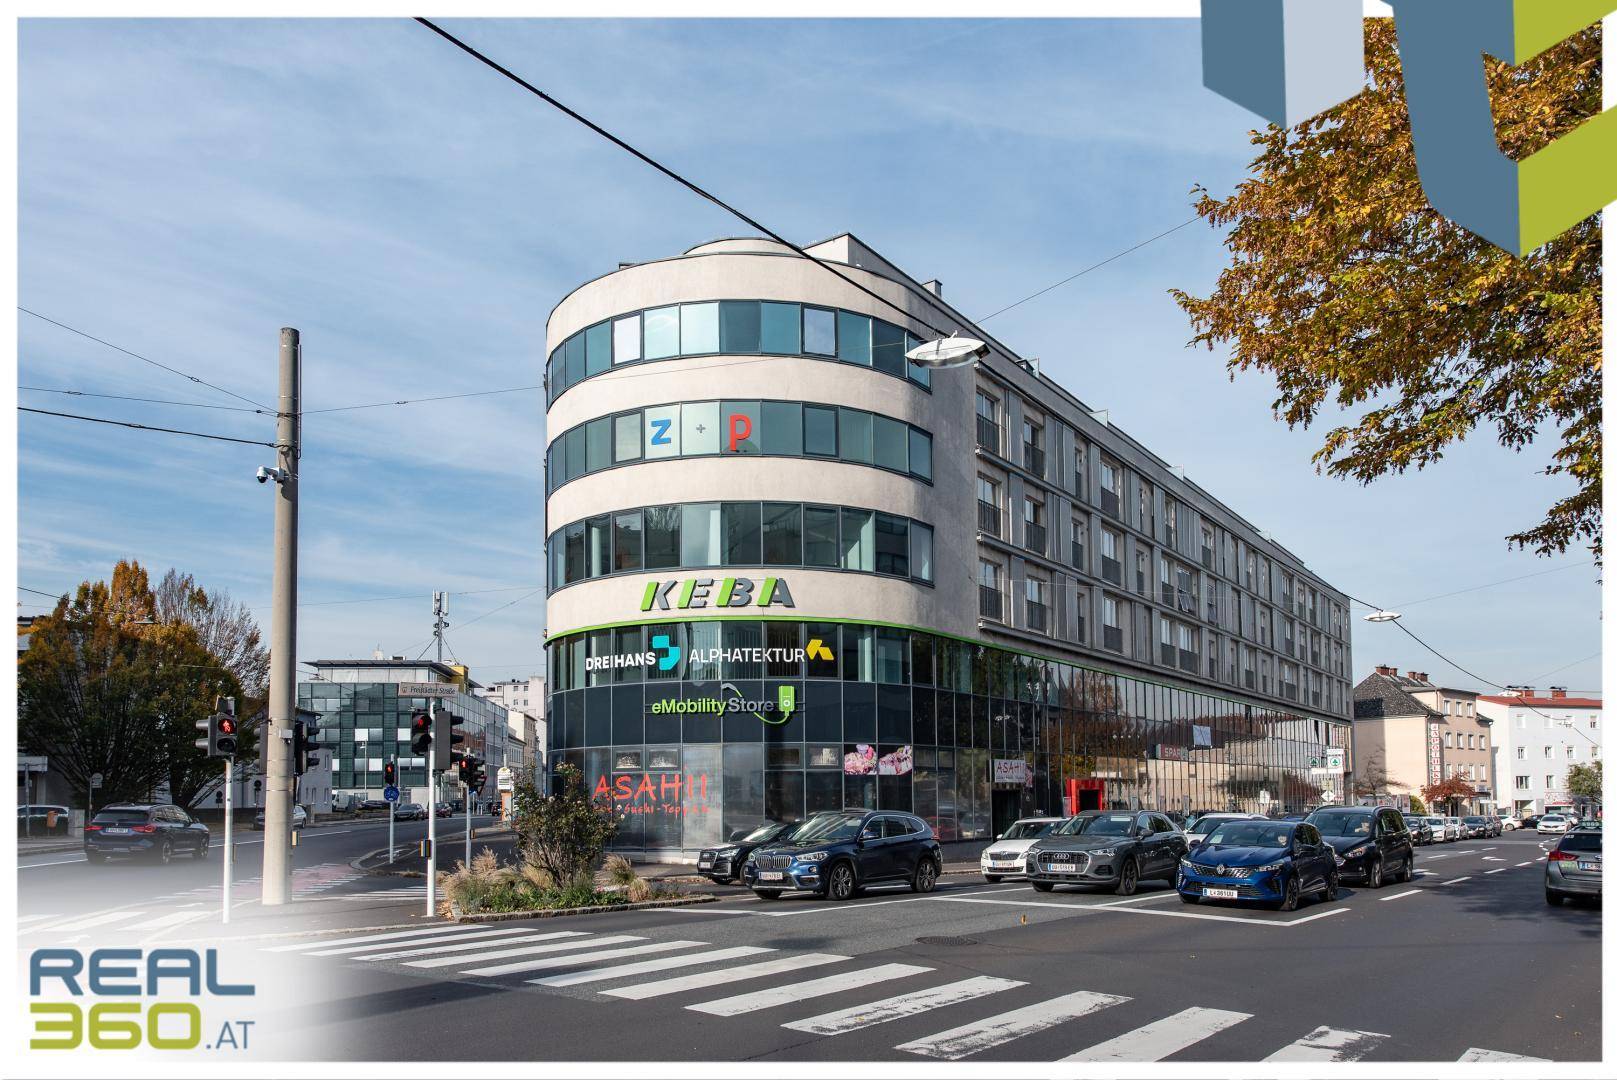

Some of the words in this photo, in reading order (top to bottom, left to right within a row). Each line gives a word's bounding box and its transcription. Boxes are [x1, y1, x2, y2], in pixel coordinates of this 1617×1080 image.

[640, 577, 795, 611] KEBA
[585, 652, 656, 671] DREIHANS
[689, 648, 805, 664] ALPHATEKTUR
[592, 772, 708, 801] ASAHII
